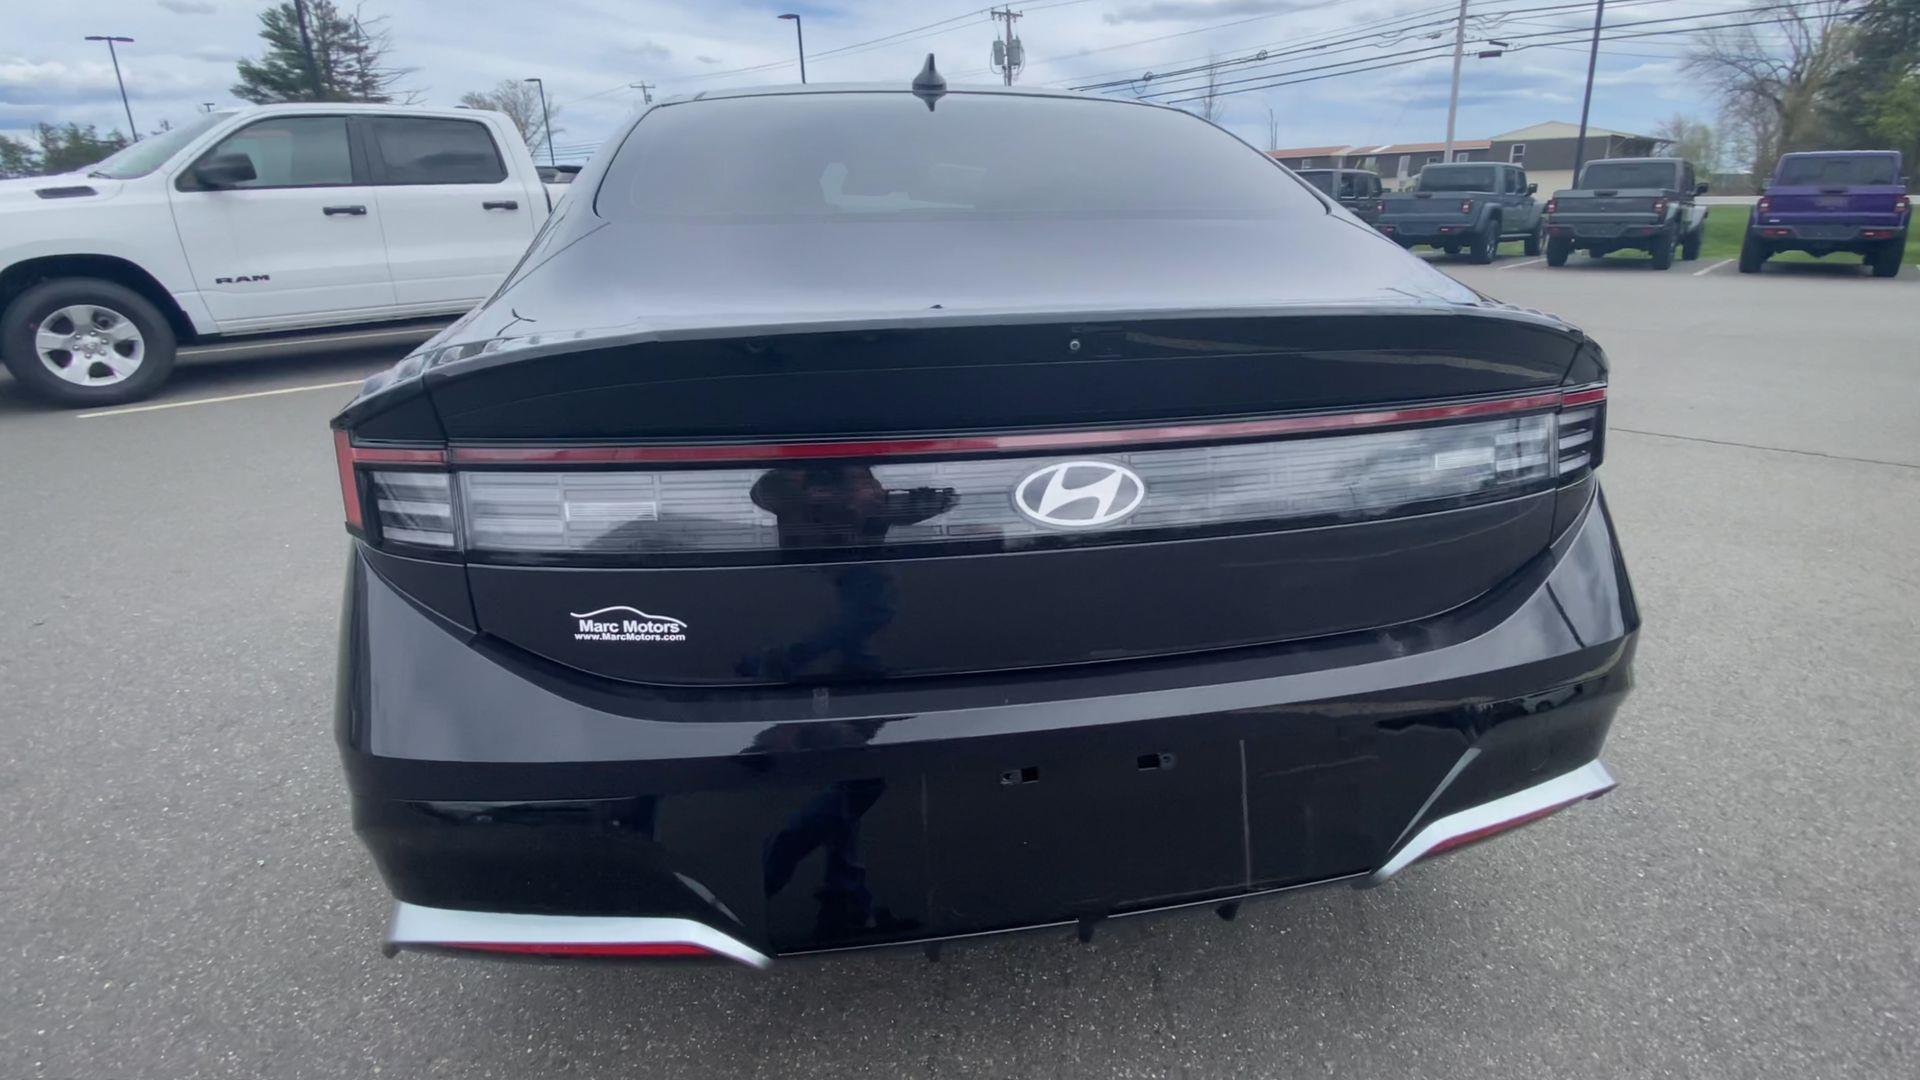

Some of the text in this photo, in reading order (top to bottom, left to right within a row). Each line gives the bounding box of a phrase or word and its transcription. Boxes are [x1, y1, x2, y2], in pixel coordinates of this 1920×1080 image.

[215, 274, 270, 284] RAM
[579, 619, 680, 633] Marc Motors
[574, 632, 686, 641] www.MarcMotors.com
